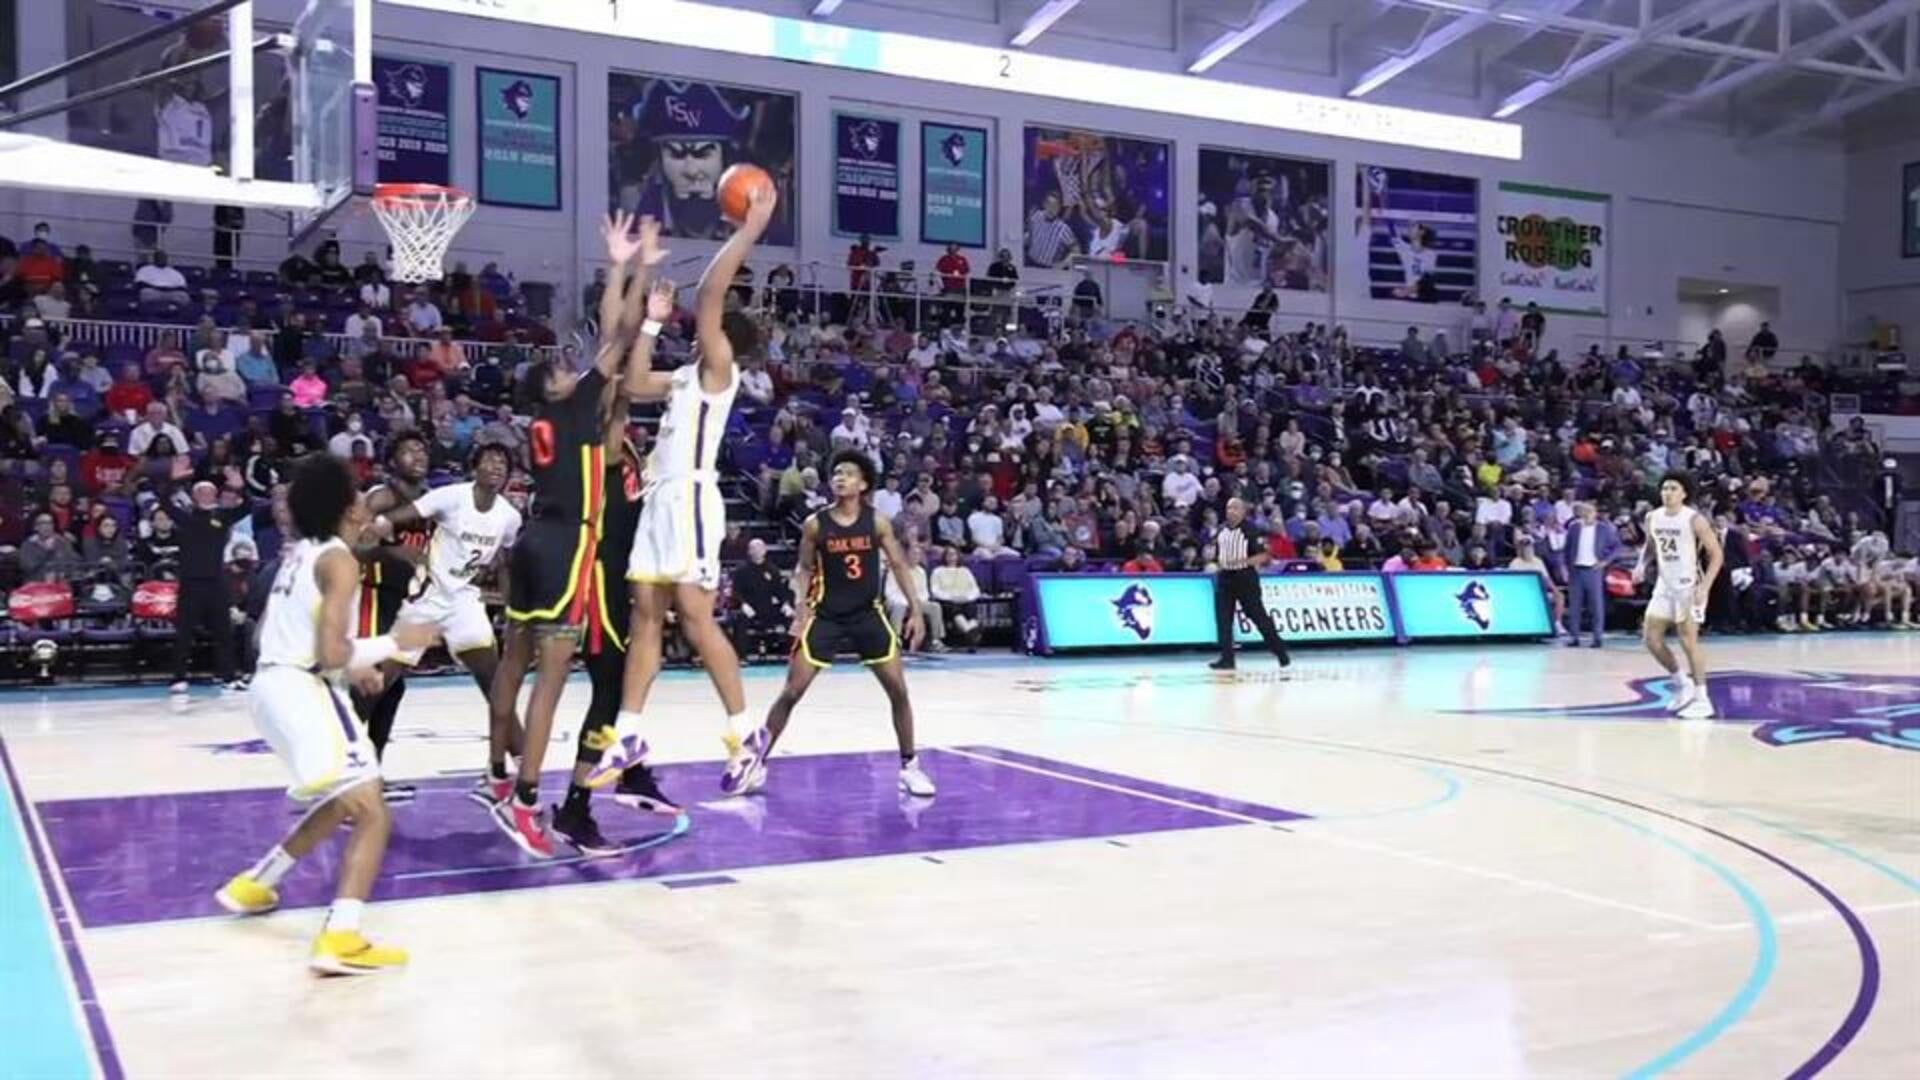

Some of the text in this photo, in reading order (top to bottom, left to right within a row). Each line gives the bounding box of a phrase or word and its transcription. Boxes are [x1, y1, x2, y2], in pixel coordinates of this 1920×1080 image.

[999, 54, 1011, 77] 2
[665, 96, 703, 128] FSW
[1497, 215, 1602, 246] CROWTHER
[1505, 241, 1592, 269] ROOFING
[530, 418, 555, 467] 0
[827, 535, 871, 553] OAK HILL
[1659, 538, 1677, 553] 24
[845, 554, 861, 579] 3
[1236, 605, 1385, 634] BCCANEERS
